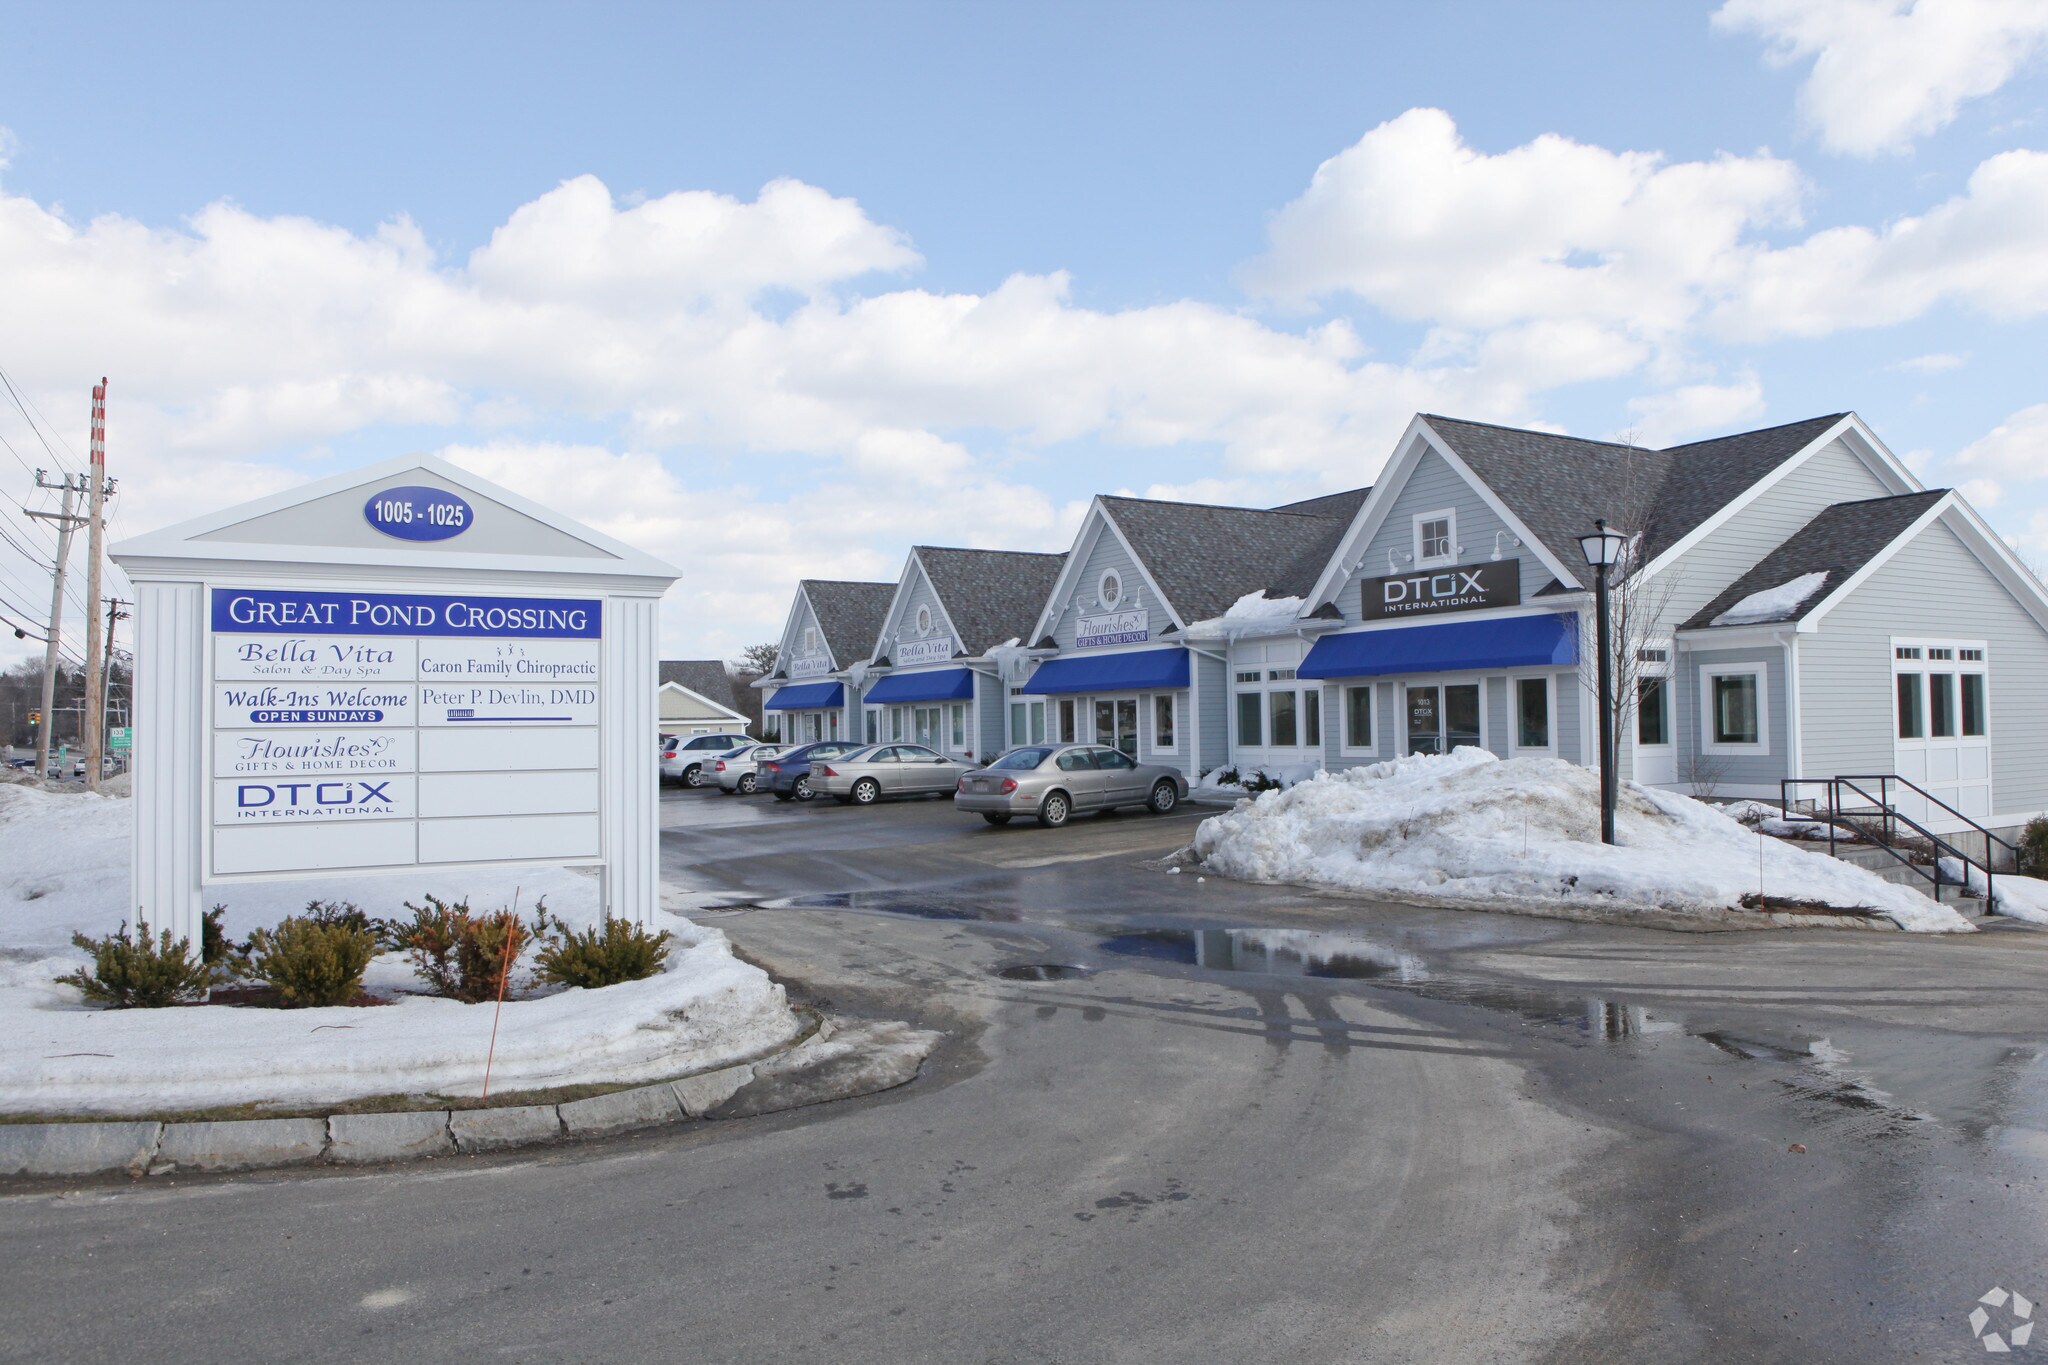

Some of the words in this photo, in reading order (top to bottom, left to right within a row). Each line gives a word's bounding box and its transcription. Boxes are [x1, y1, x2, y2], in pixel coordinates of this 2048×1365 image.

[375, 500, 413, 524] 1005
[427, 504, 464, 527] 1025
[1385, 595, 1486, 613] INTERNATIONAL
[1080, 615, 1135, 636] Flourishes
[1078, 637, 1096, 647] GIFTS
[1096, 637, 1102, 645] &
[1103, 634, 1122, 645] HOME
[1123, 632, 1147, 643] DECOR
[238, 640, 318, 662] Bella
[329, 644, 395, 663] Vita
[900, 643, 924, 657] Bella
[926, 642, 948, 653] Vita
[252, 663, 291, 674] Salon
[301, 666, 316, 675] &
[321, 665, 352, 679] Day
[356, 665, 381, 679] Spa
[421, 658, 463, 673] Caron
[467, 659, 512, 678] Family
[516, 659, 596, 678] Chiropractic
[224, 687, 319, 707] Walk-Ins
[326, 688, 407, 707] Welcome
[423, 689, 465, 704] Peter
[471, 689, 482, 704] P.
[489, 689, 545, 707] Devlin,
[550, 690, 595, 704] DMD
[258, 711, 300, 722] OPEN
[307, 711, 376, 722] SUNDAYS
[236, 736, 370, 760] Flourishes
[235, 761, 278, 771] GIFTS
[285, 762, 295, 770] &
[302, 760, 343, 769] HOME
[350, 759, 397, 769] DECOR
[238, 806, 394, 818] INTERNATIONAL
